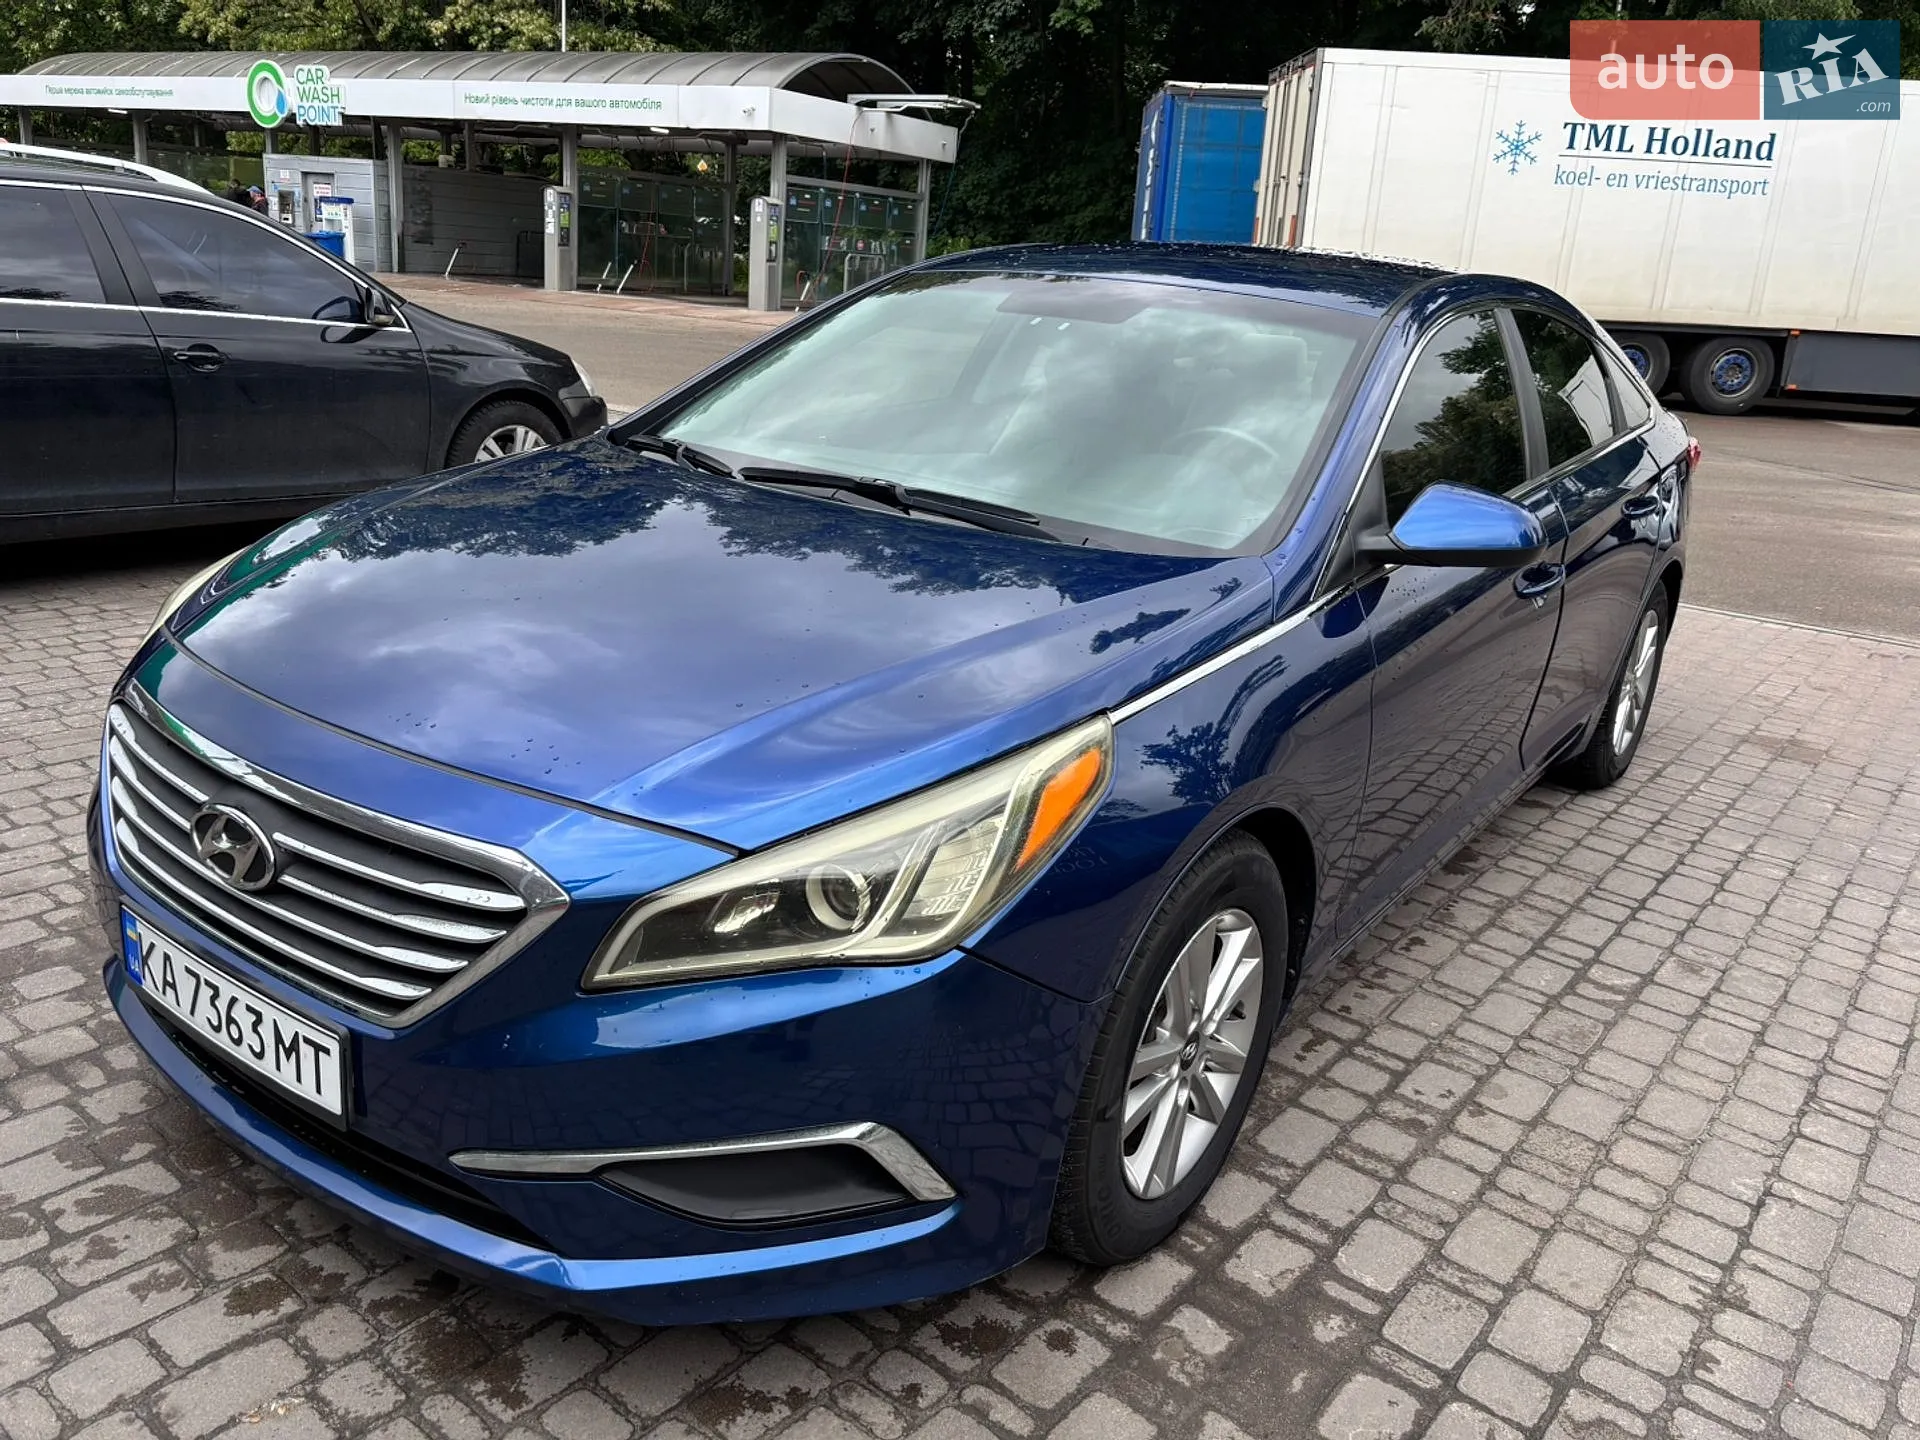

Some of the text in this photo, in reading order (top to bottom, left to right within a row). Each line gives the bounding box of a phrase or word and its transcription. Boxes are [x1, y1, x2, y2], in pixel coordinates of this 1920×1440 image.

[296, 68, 325, 85] CAR
[296, 86, 340, 103] WASH
[464, 92, 662, 110] Новий рівень чистоти для вашого автомобіля
[297, 105, 339, 123] POINT
[1563, 121, 1777, 162] TML Holland
[1554, 164, 1769, 199] koel- en vriestransport
